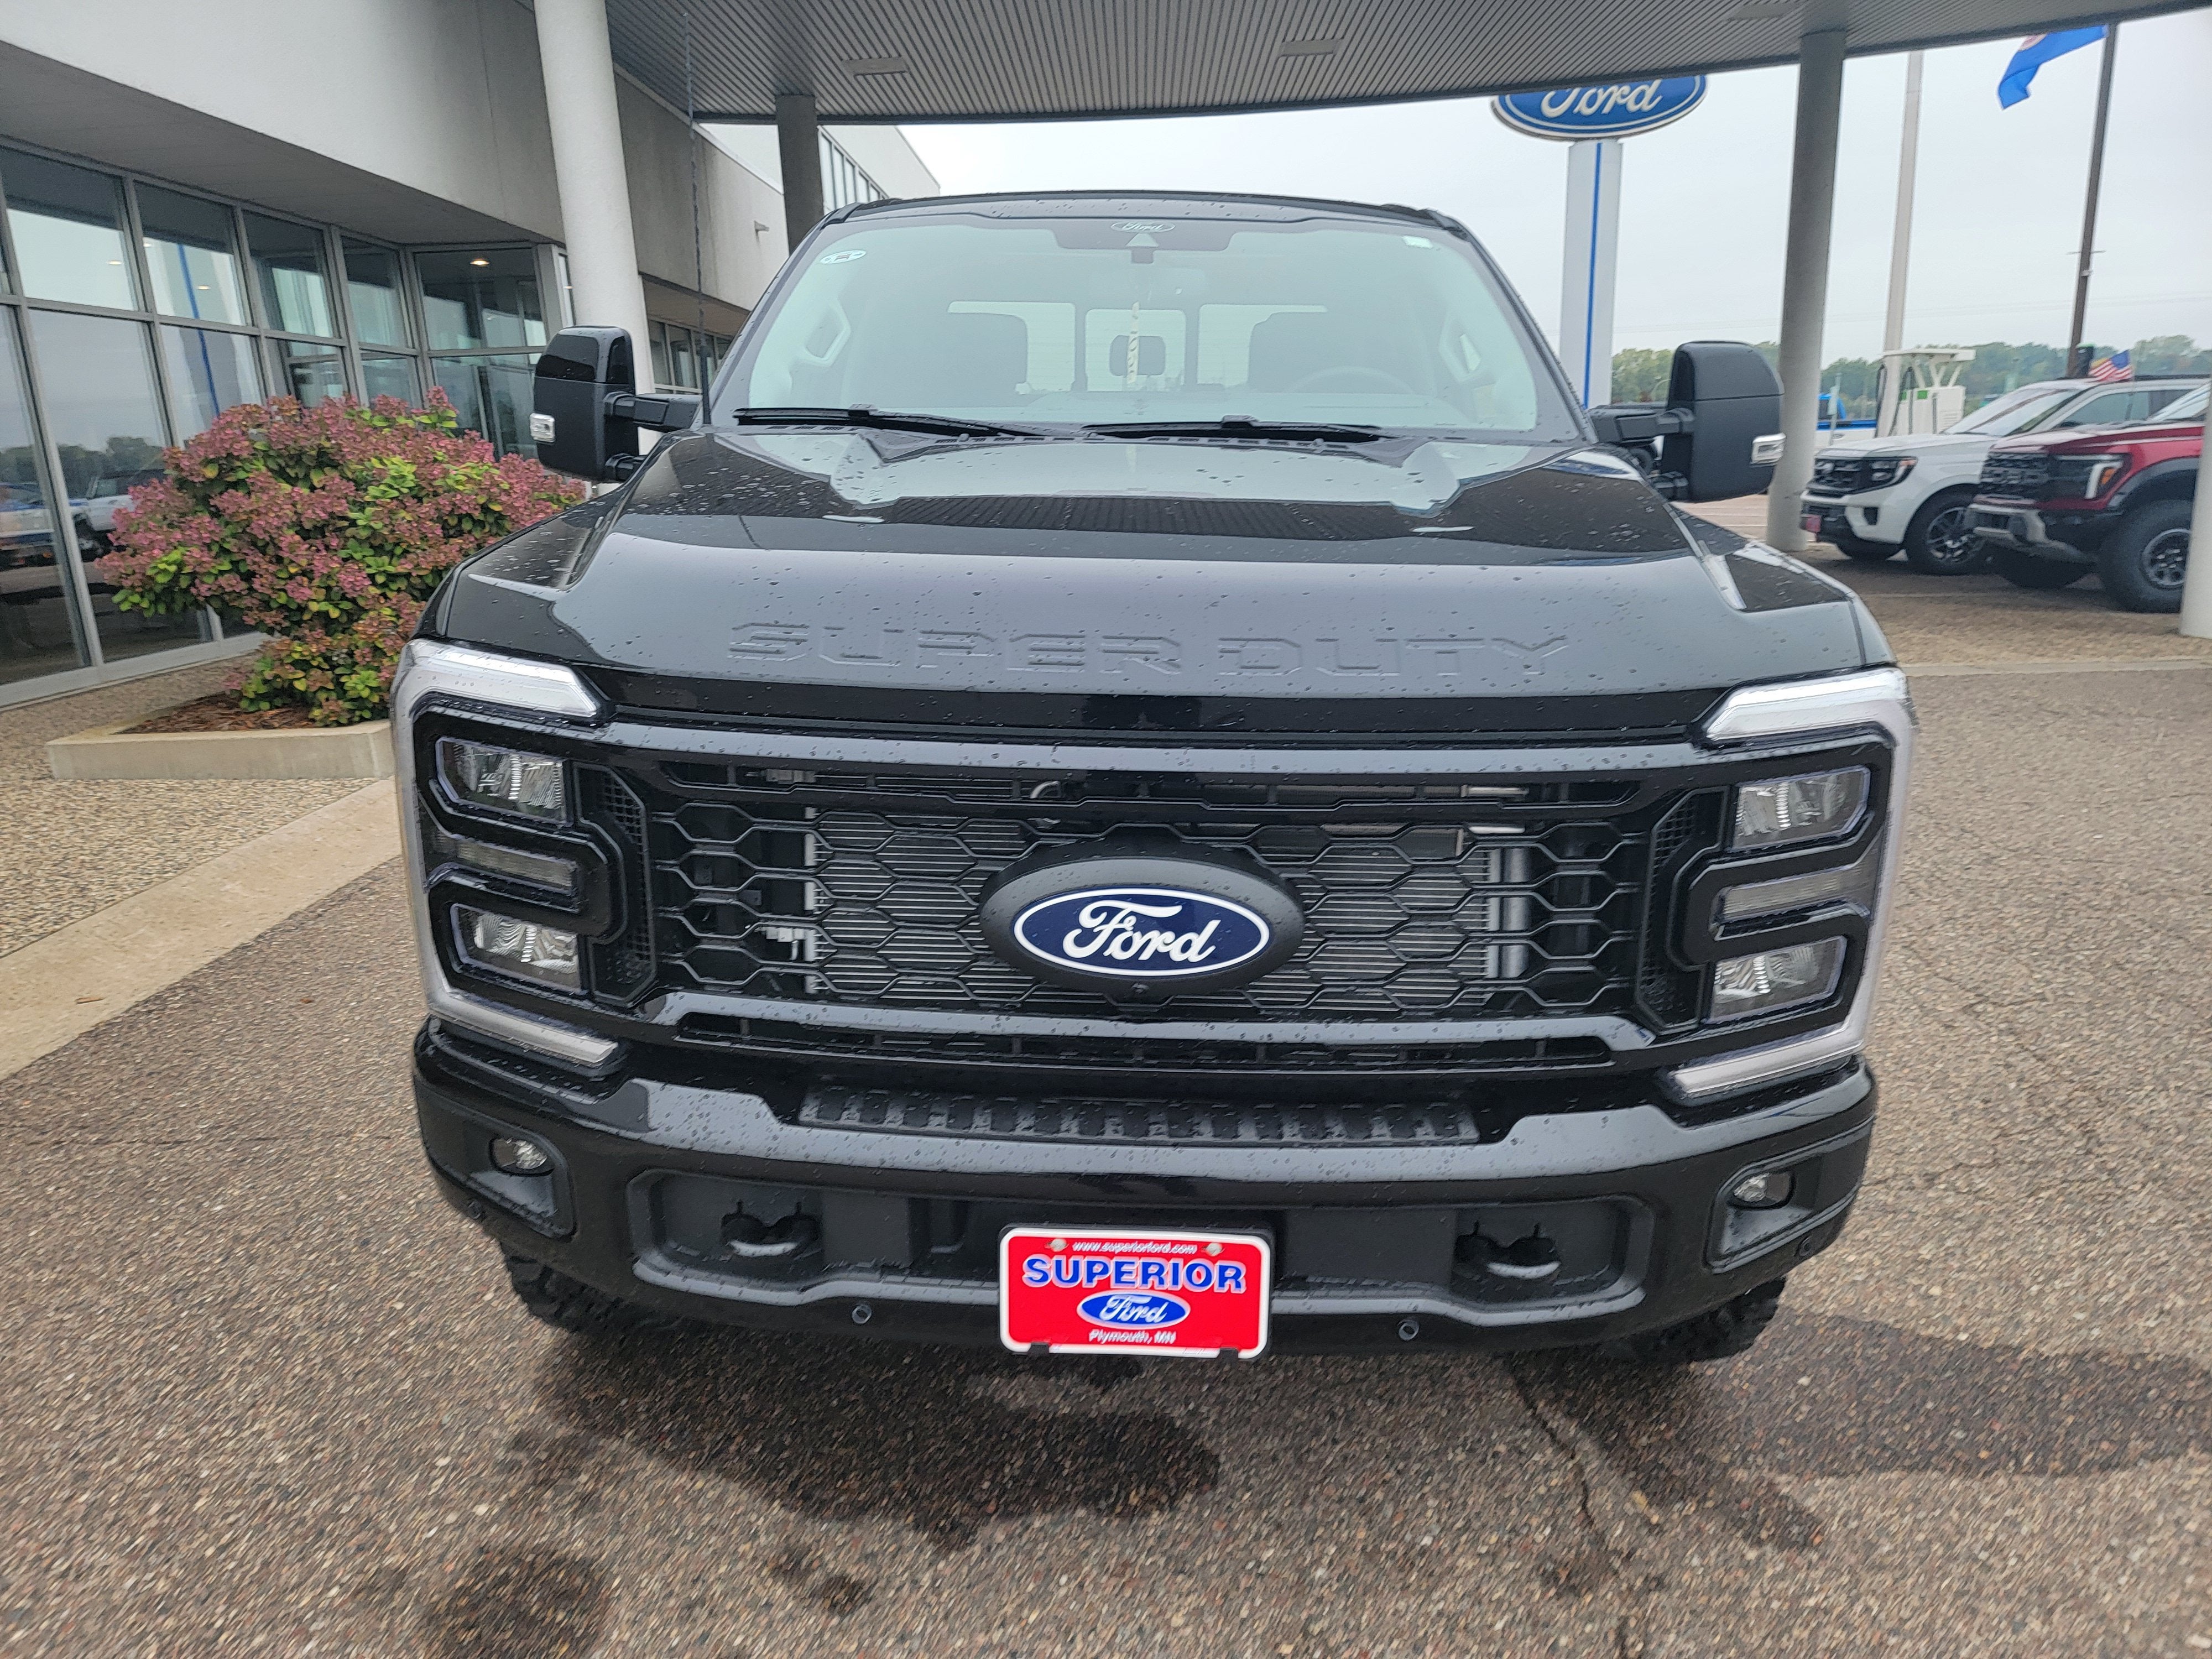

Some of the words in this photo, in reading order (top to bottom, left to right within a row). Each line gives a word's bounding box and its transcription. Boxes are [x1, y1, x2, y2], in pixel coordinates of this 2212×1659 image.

[727, 622, 1181, 674] SUPER
[1218, 635, 1569, 676] DUTY
[1062, 900, 1221, 963] Ford
[1072, 1240, 1198, 1255] www.superiorford.com
[1022, 1254, 1246, 1294] SUPERIOR
[1099, 1295, 1168, 1323] Ford
[1088, 1328, 1152, 1344] Plymouth,
[1154, 1330, 1177, 1344] MN
